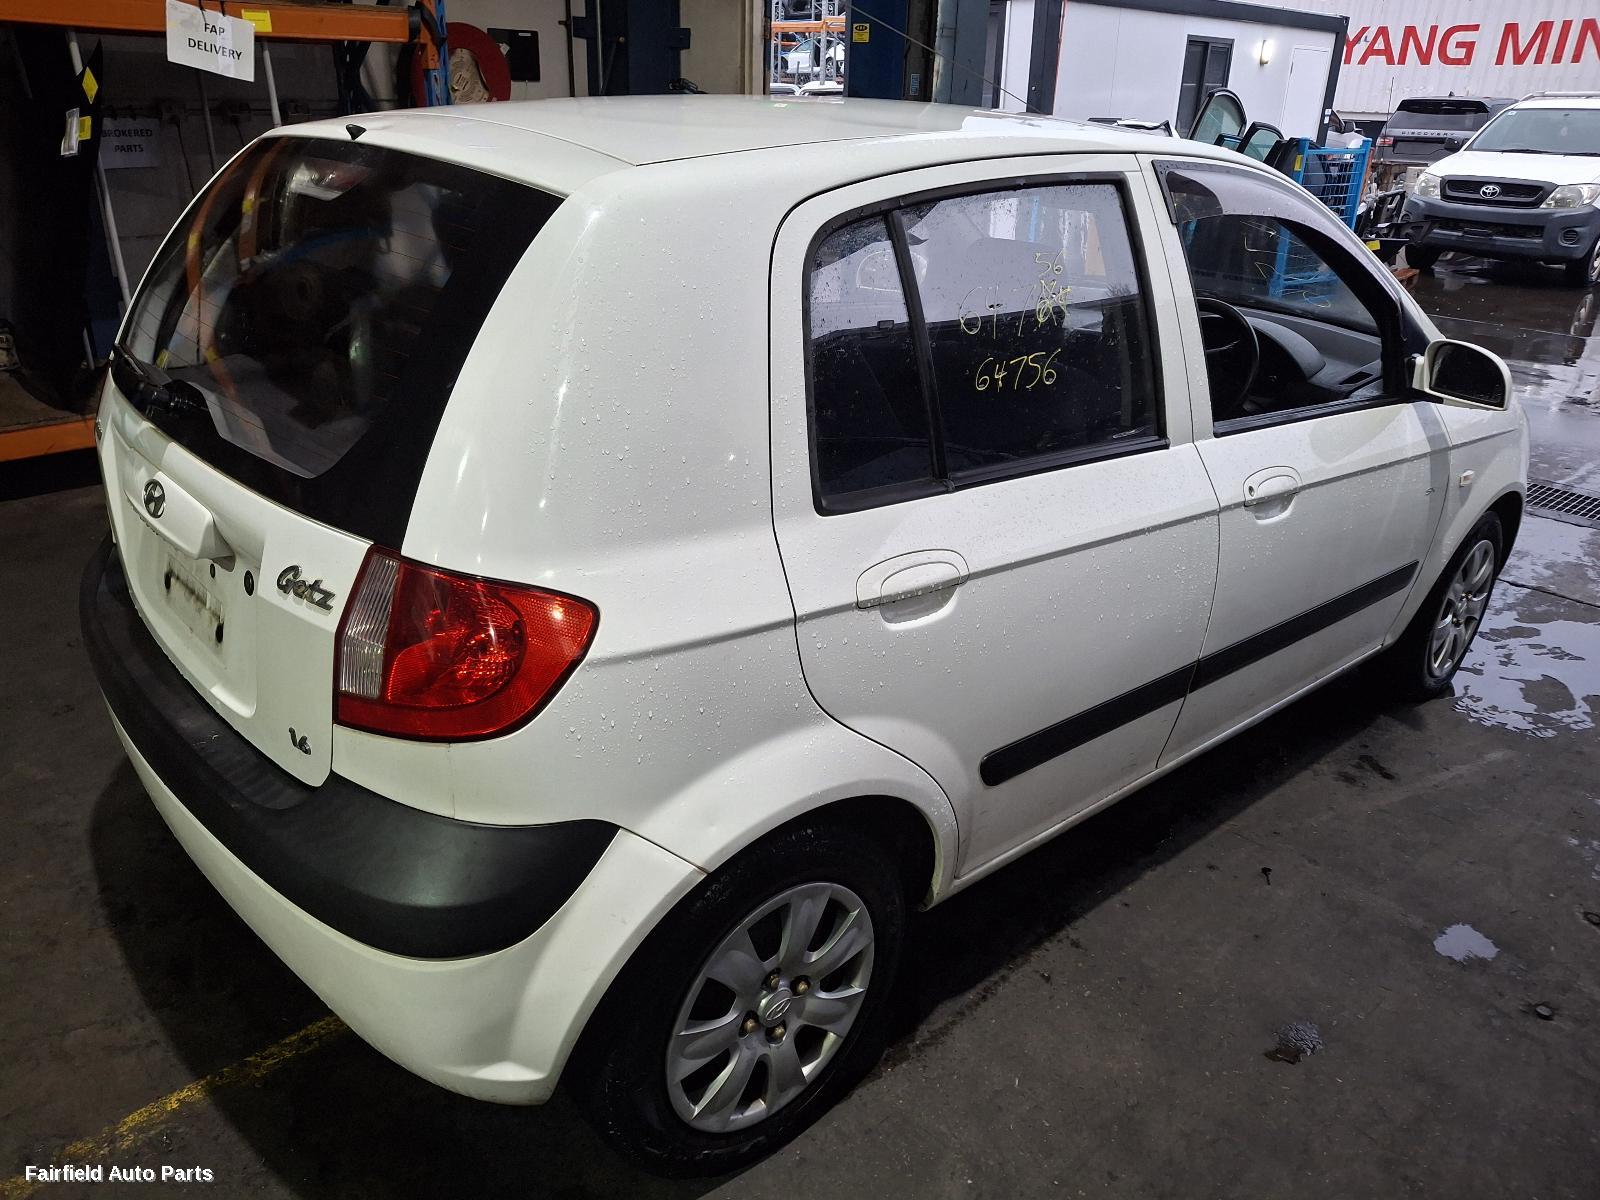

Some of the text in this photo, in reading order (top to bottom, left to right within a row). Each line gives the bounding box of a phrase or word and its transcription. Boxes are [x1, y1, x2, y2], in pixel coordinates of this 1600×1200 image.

[204, 23, 225, 36] FAP
[188, 38, 243, 61] DELIVERY
[1344, 23, 1481, 66] YANG
[101, 127, 153, 138] BROKERED
[114, 144, 144, 152] PARTS
[975, 348, 1062, 393] 64756
[276, 564, 336, 611] Getz
